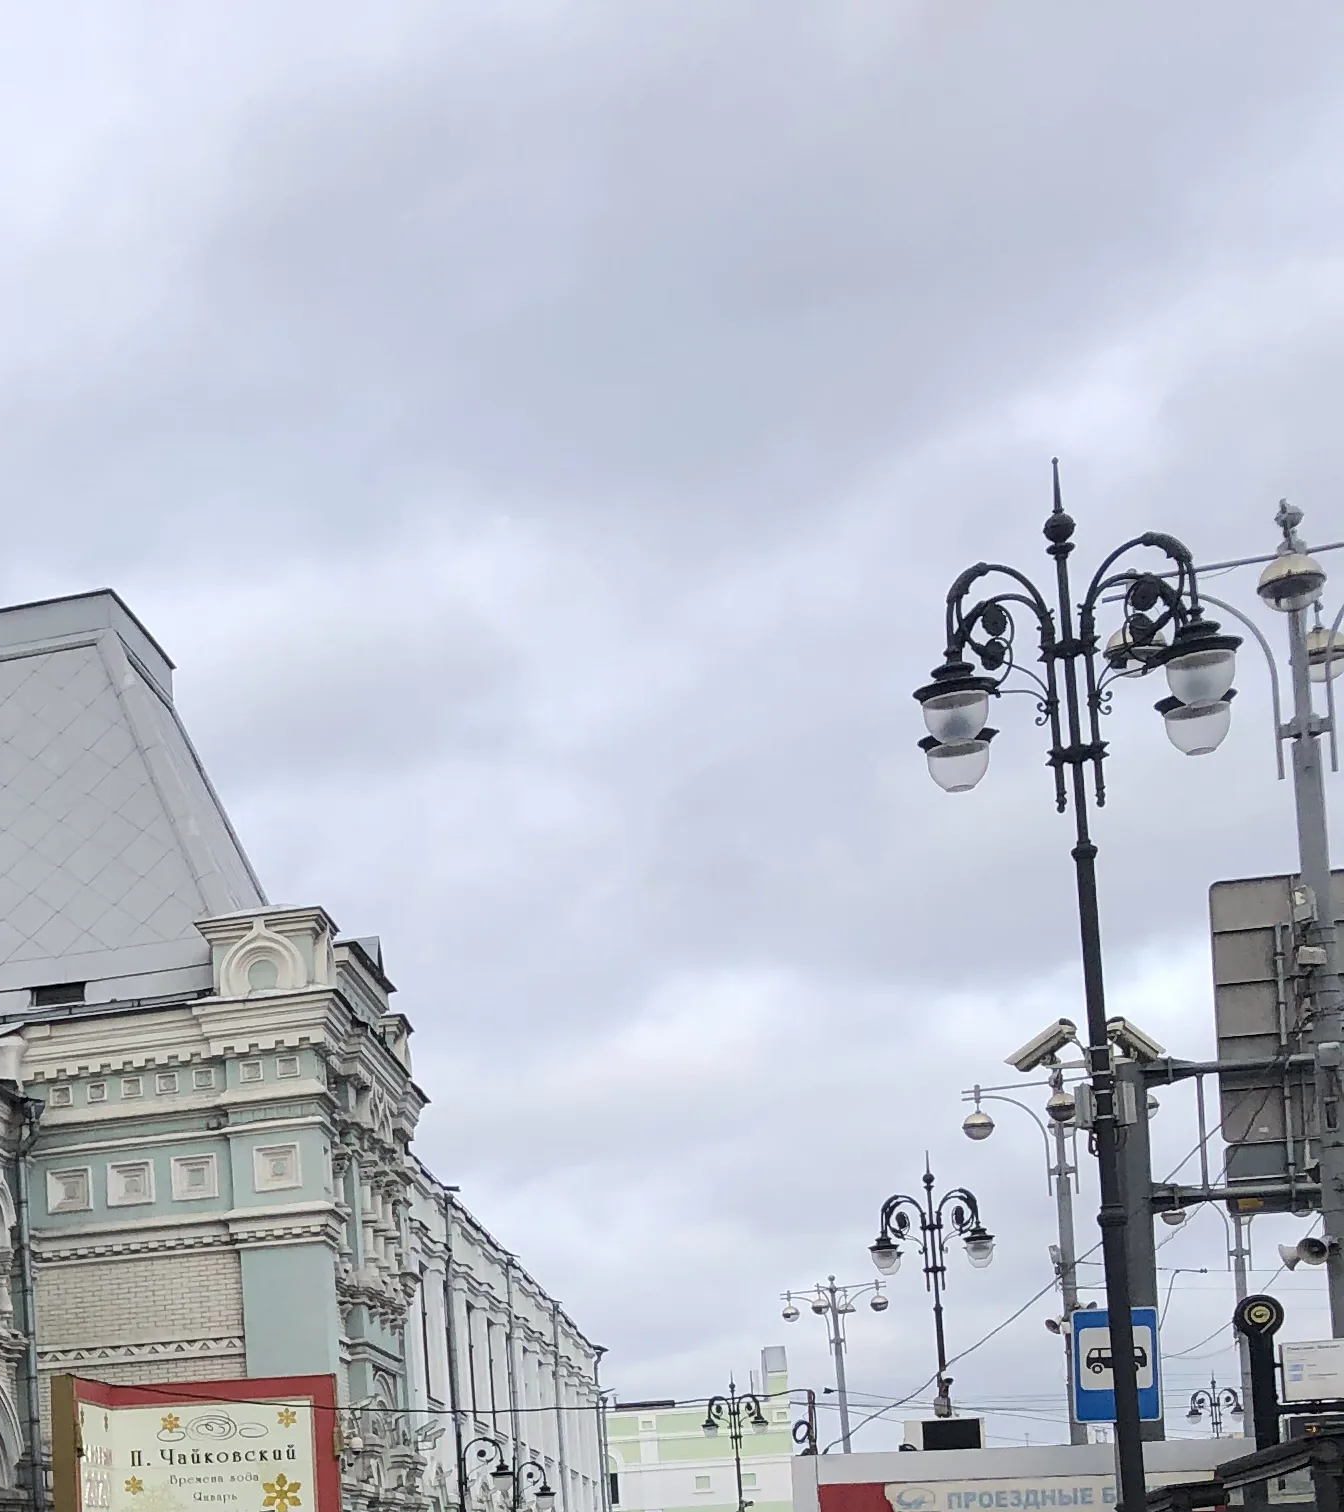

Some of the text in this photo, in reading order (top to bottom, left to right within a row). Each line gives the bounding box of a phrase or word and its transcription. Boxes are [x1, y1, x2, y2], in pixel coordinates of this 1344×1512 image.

[130, 1450, 152, 1468] П.
[160, 1444, 297, 1466] Чайковский
[947, 1487, 1094, 1510] ПРОЕЗДНЫЕ
